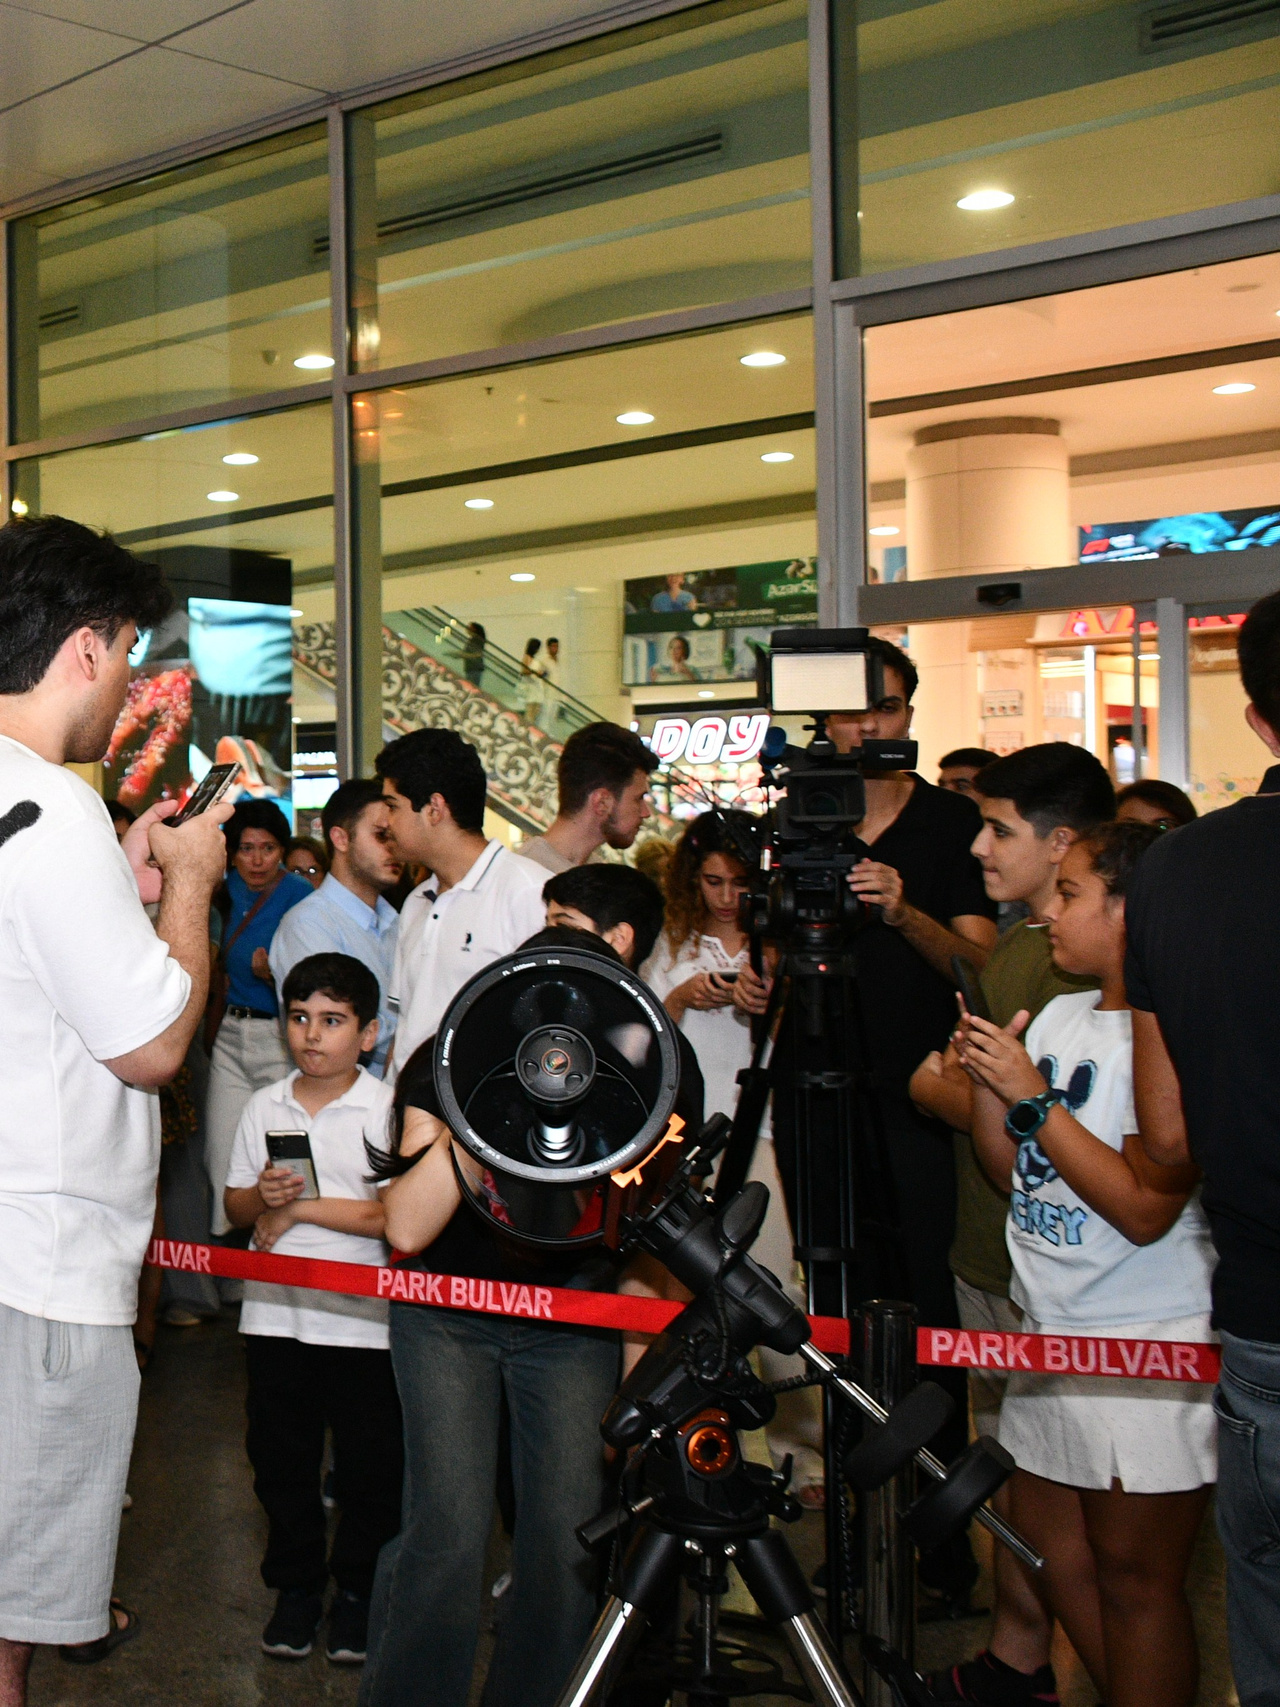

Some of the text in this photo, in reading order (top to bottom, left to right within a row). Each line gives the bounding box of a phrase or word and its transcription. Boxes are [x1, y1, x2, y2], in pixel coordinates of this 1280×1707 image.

[651, 714, 771, 764] DOY
[146, 1239, 211, 1274] ULVAR
[376, 1268, 553, 1319] PARK BULVAR
[930, 1330, 1201, 1381] PARK BULVAR
